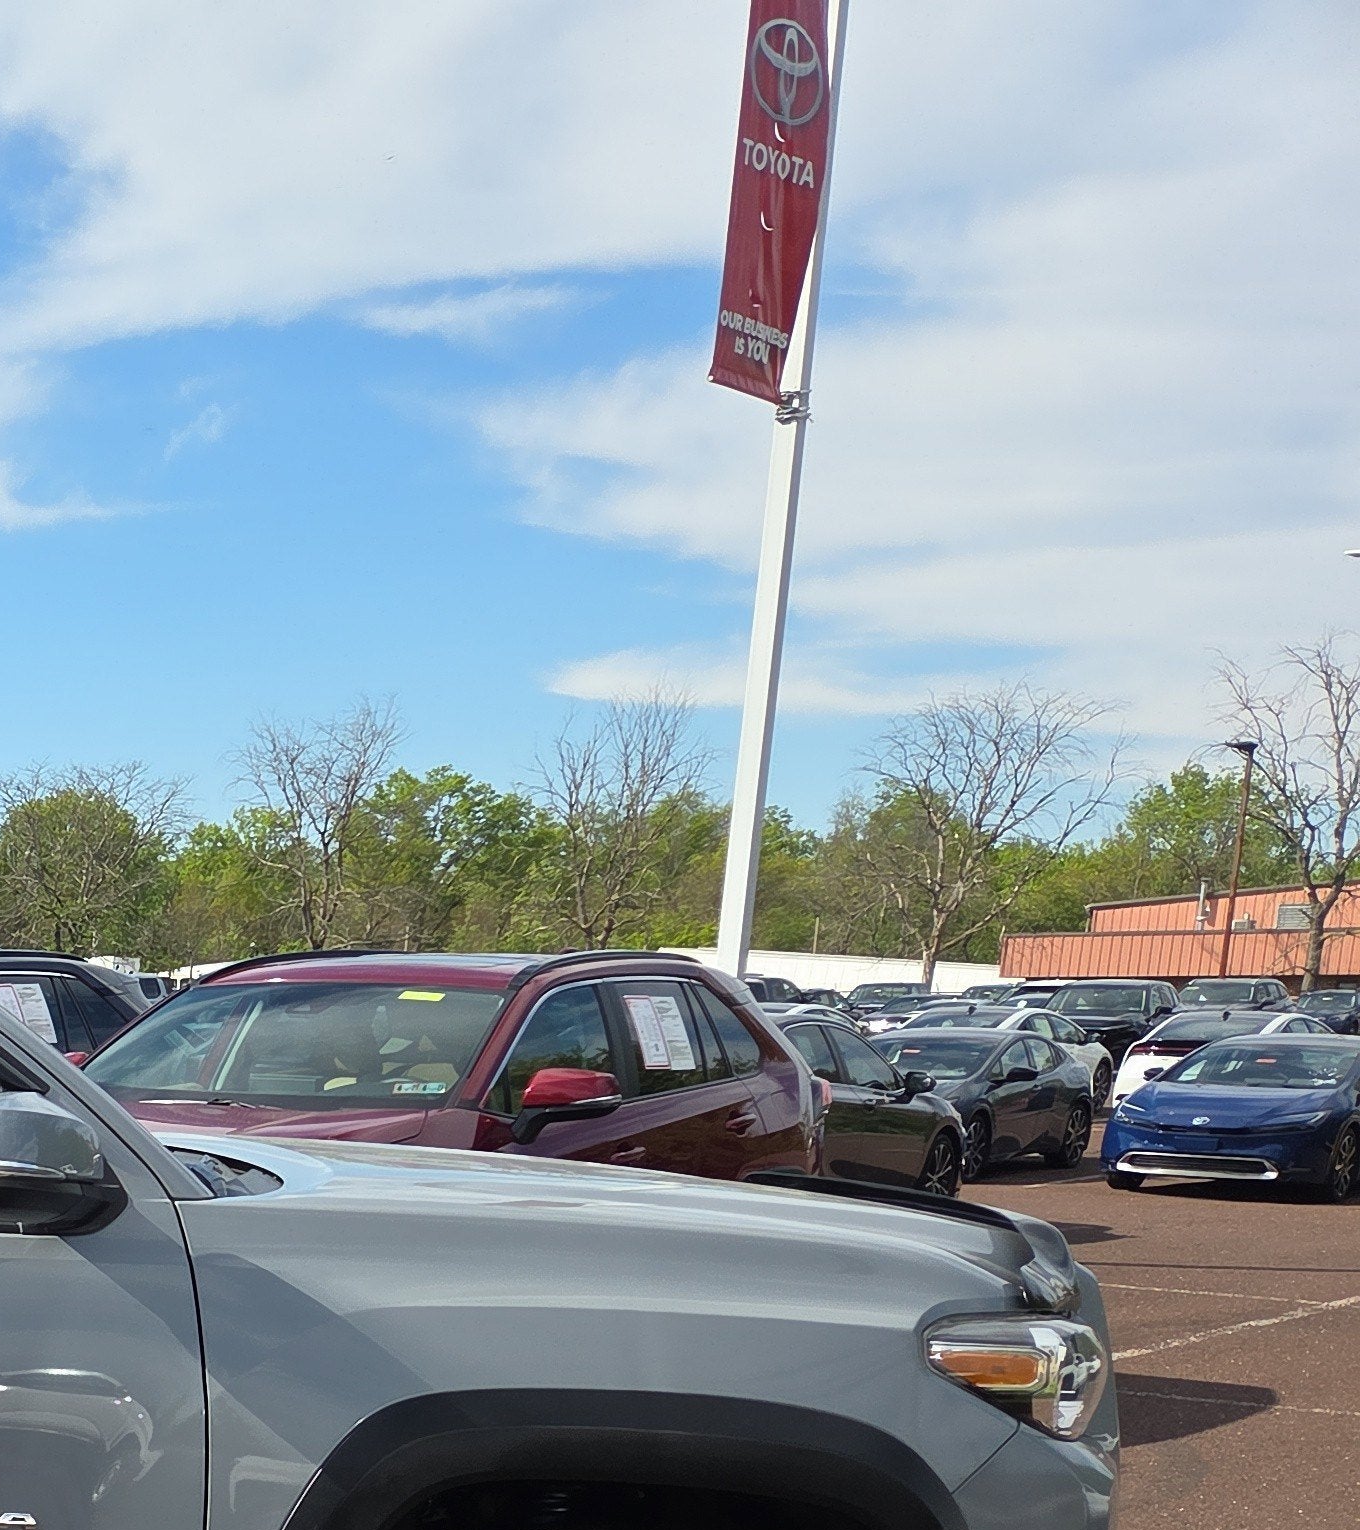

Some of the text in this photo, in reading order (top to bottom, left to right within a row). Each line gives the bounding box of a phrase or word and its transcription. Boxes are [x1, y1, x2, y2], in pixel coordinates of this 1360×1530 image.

[743, 138, 814, 189] TOYOTA
[721, 310, 788, 349] OUR BUSINES
[734, 336, 770, 364] IS YOU
